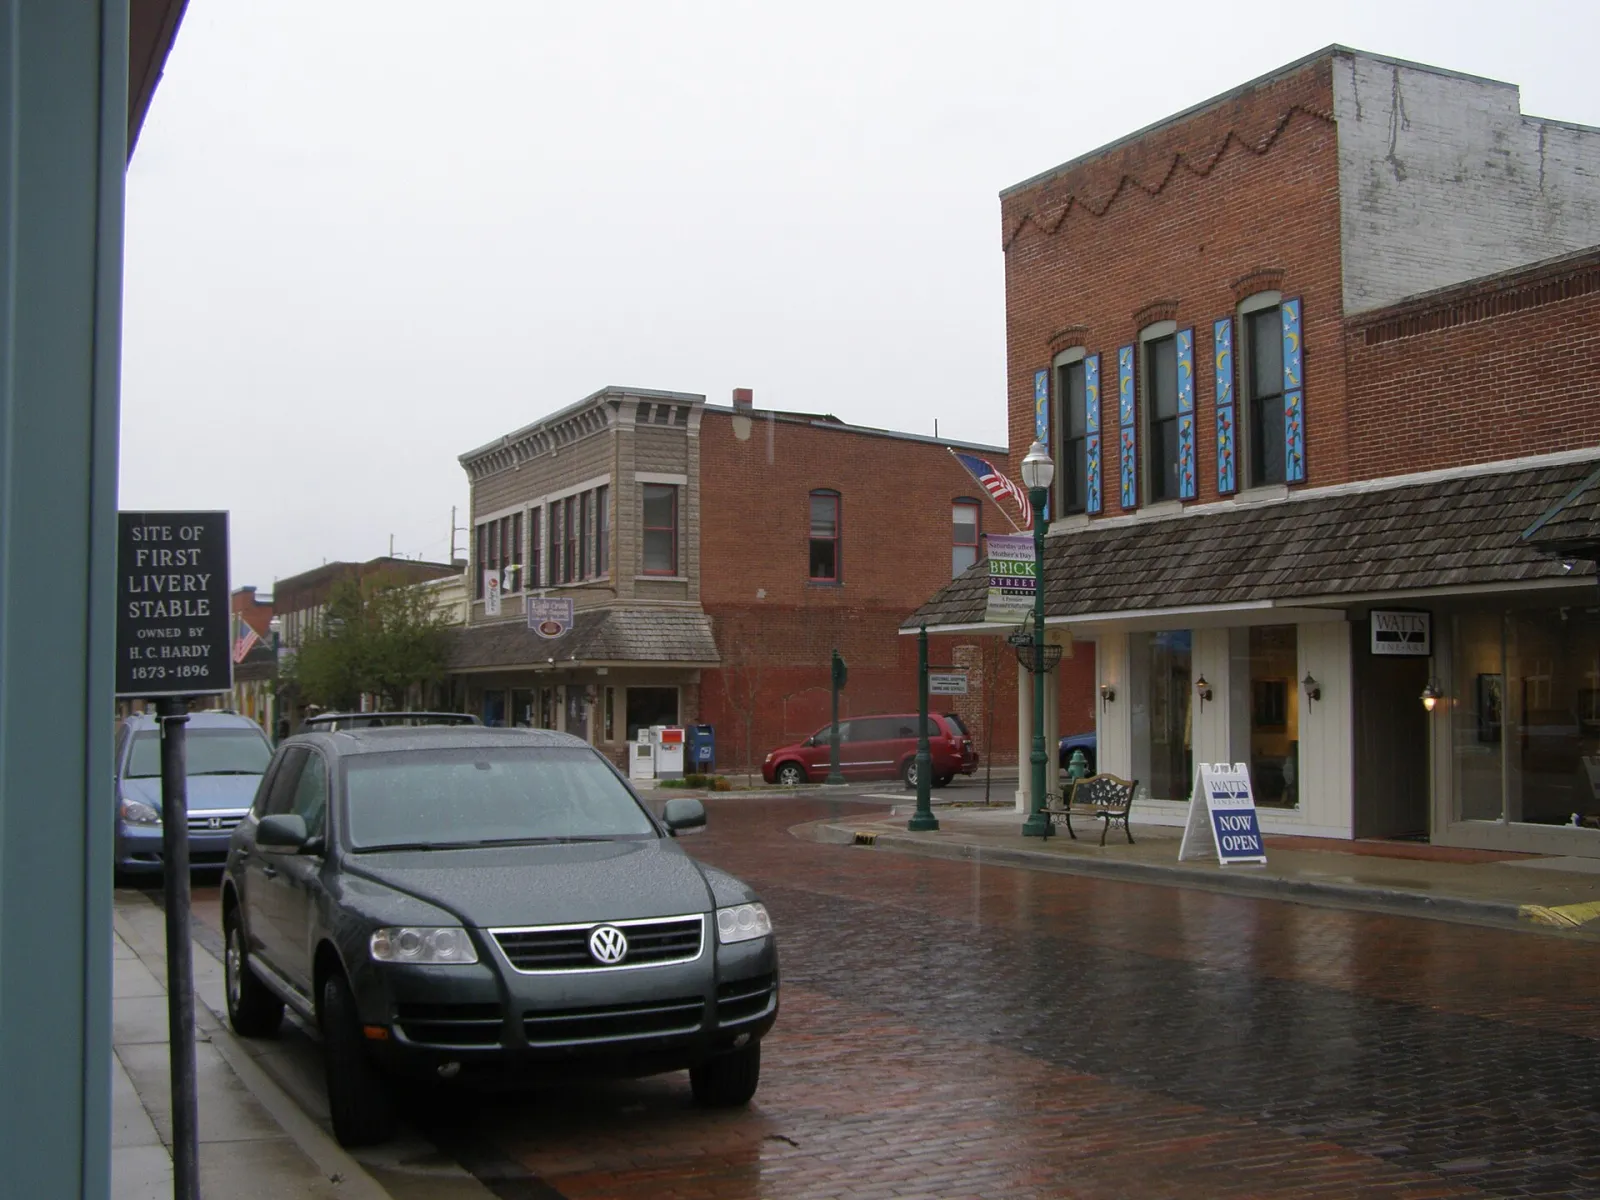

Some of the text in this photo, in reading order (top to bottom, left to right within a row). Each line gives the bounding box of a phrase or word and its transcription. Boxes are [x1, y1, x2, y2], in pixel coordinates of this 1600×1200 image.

[132, 526, 205, 541] SITE OF
[136, 549, 201, 567] FIRST
[1020, 552, 1032, 560] Day
[990, 561, 1036, 575] BRICK
[129, 573, 212, 593] LIVERY
[990, 577, 1036, 588] STREET
[129, 599, 210, 618] STABLE
[1376, 614, 1425, 631] WATTS
[137, 627, 204, 639] OWNED BY
[129, 645, 212, 659] H. C. HARDY
[132, 664, 209, 679] 1873-1896
[1210, 780, 1249, 791] WATTS
[1218, 815, 1252, 831] NOW
[1222, 835, 1259, 851] OPEN
